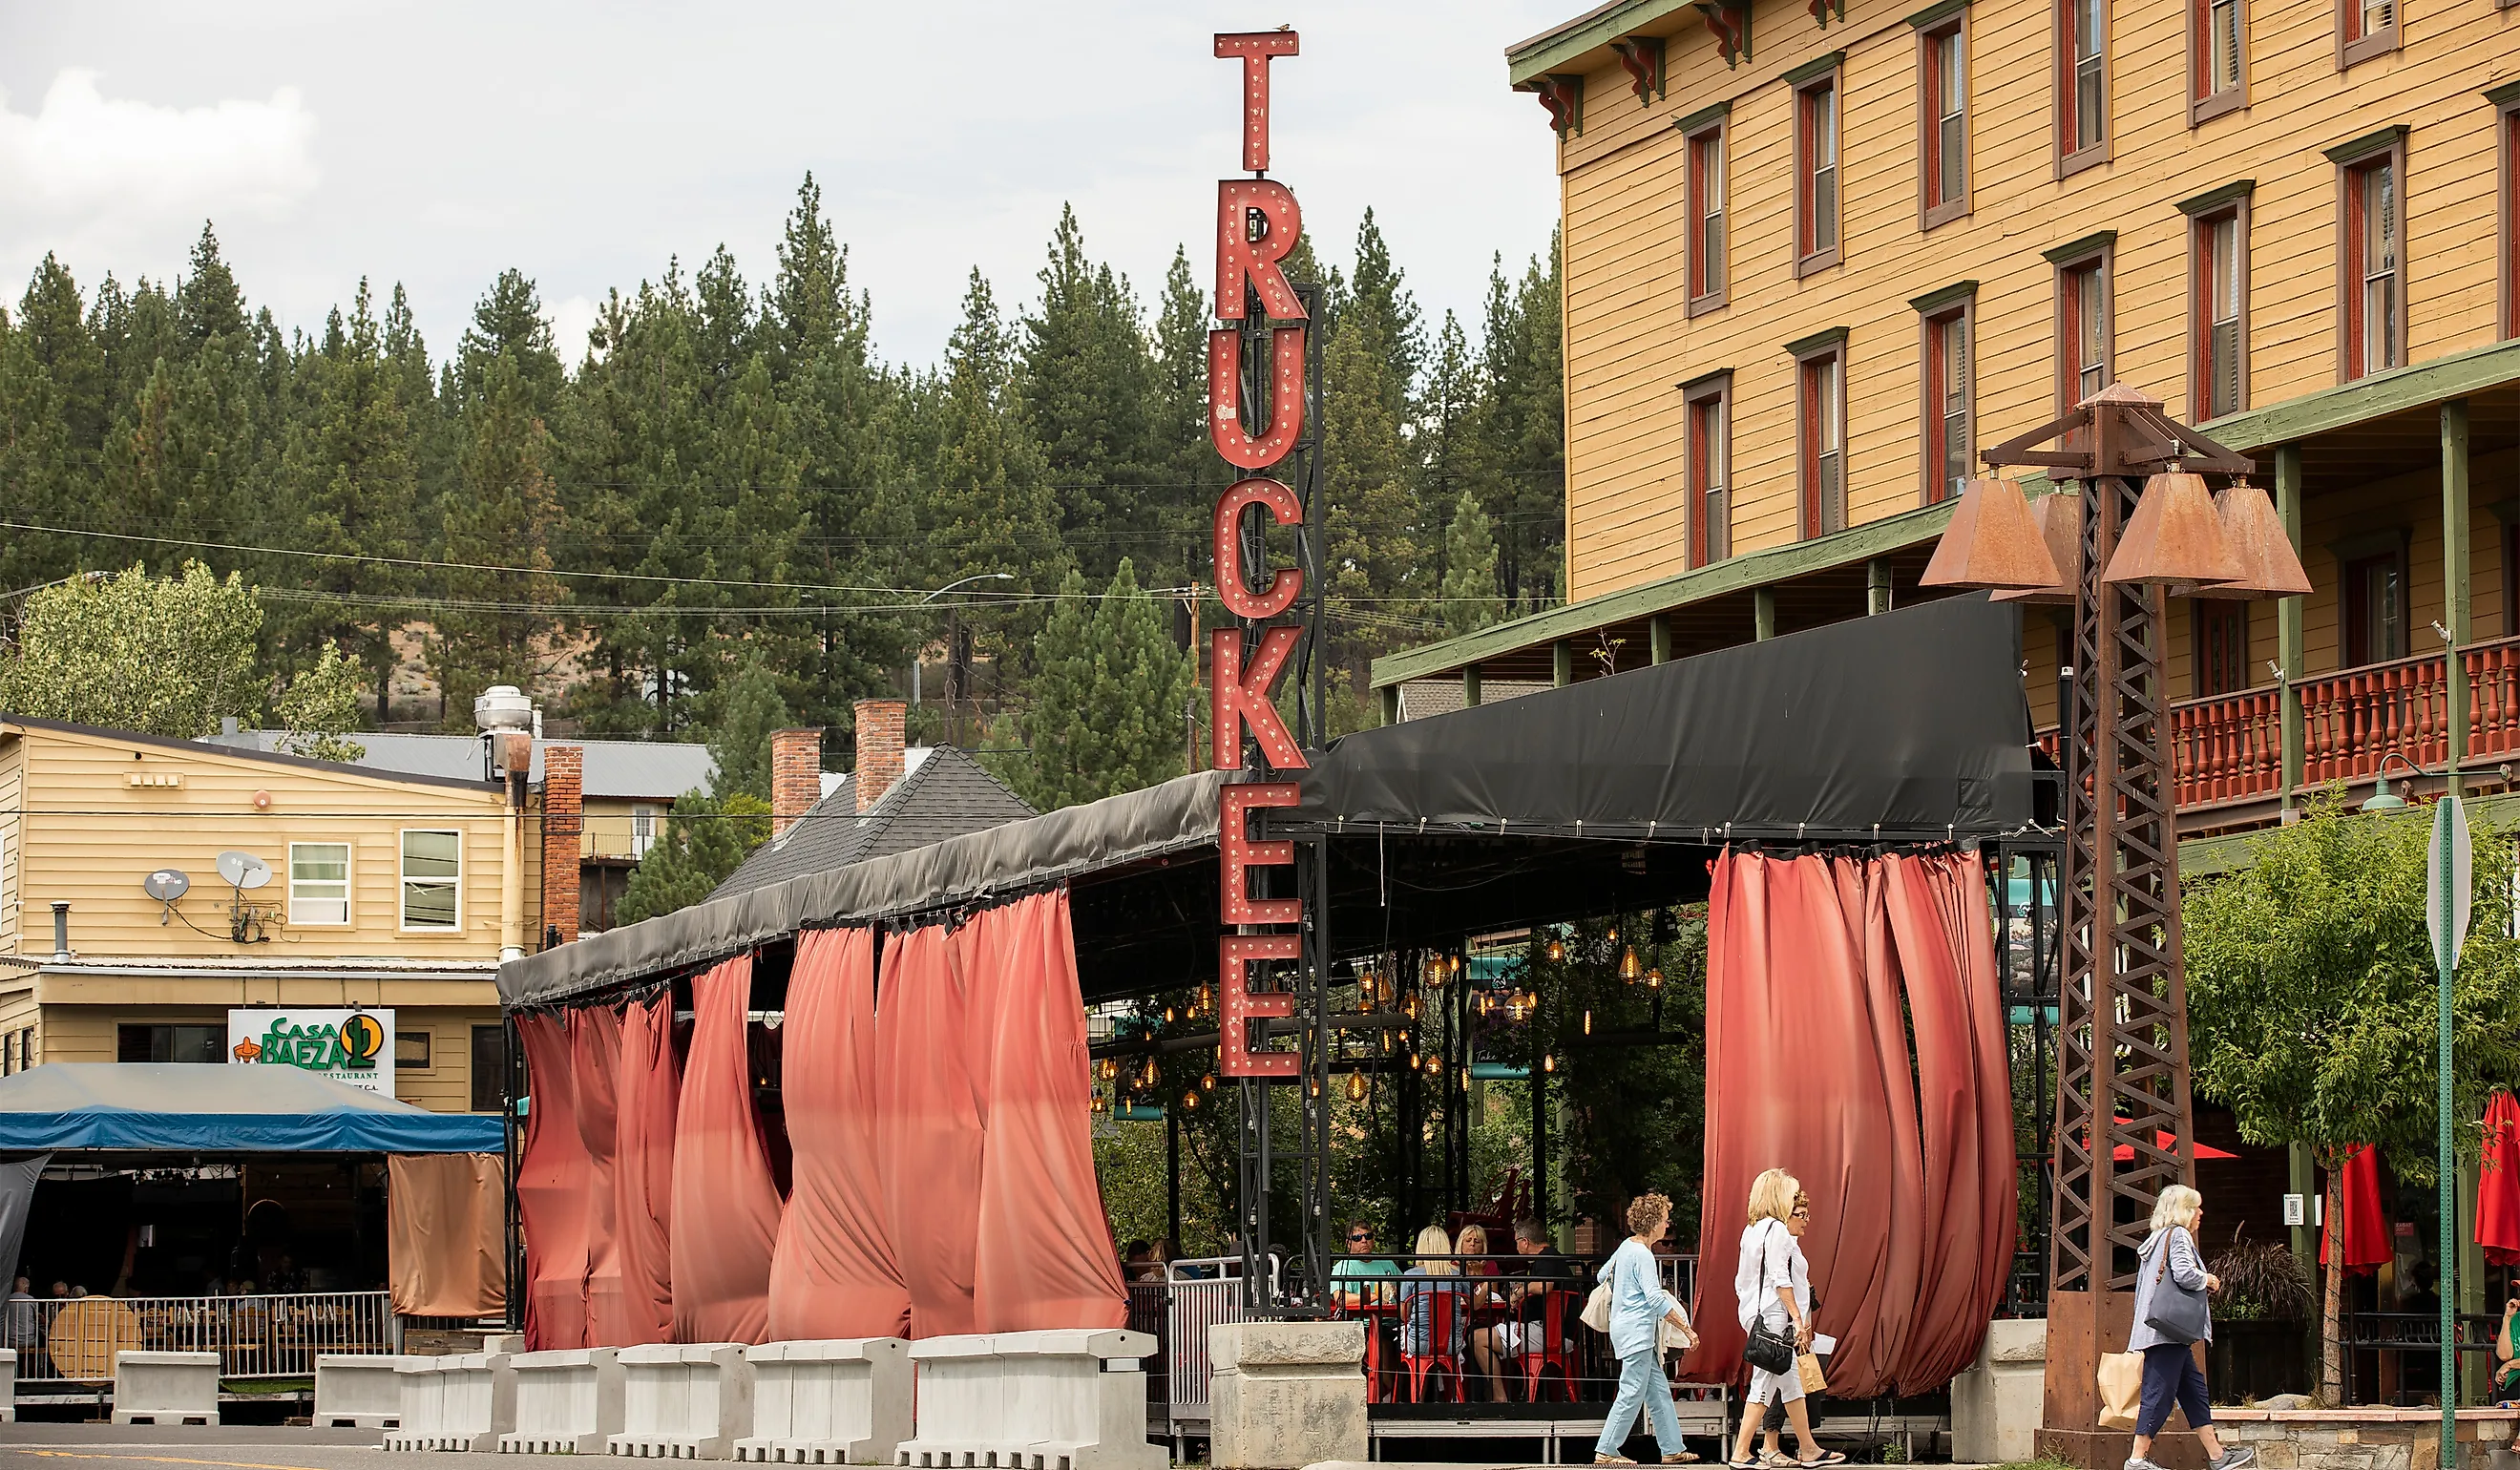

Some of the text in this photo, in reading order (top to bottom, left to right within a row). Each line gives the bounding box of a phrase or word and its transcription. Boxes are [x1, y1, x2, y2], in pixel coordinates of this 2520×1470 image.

[1208, 31, 1311, 1077] TRUCKEE
[270, 1017, 339, 1040] CASA
[262, 1033, 348, 1070] BAEZA
